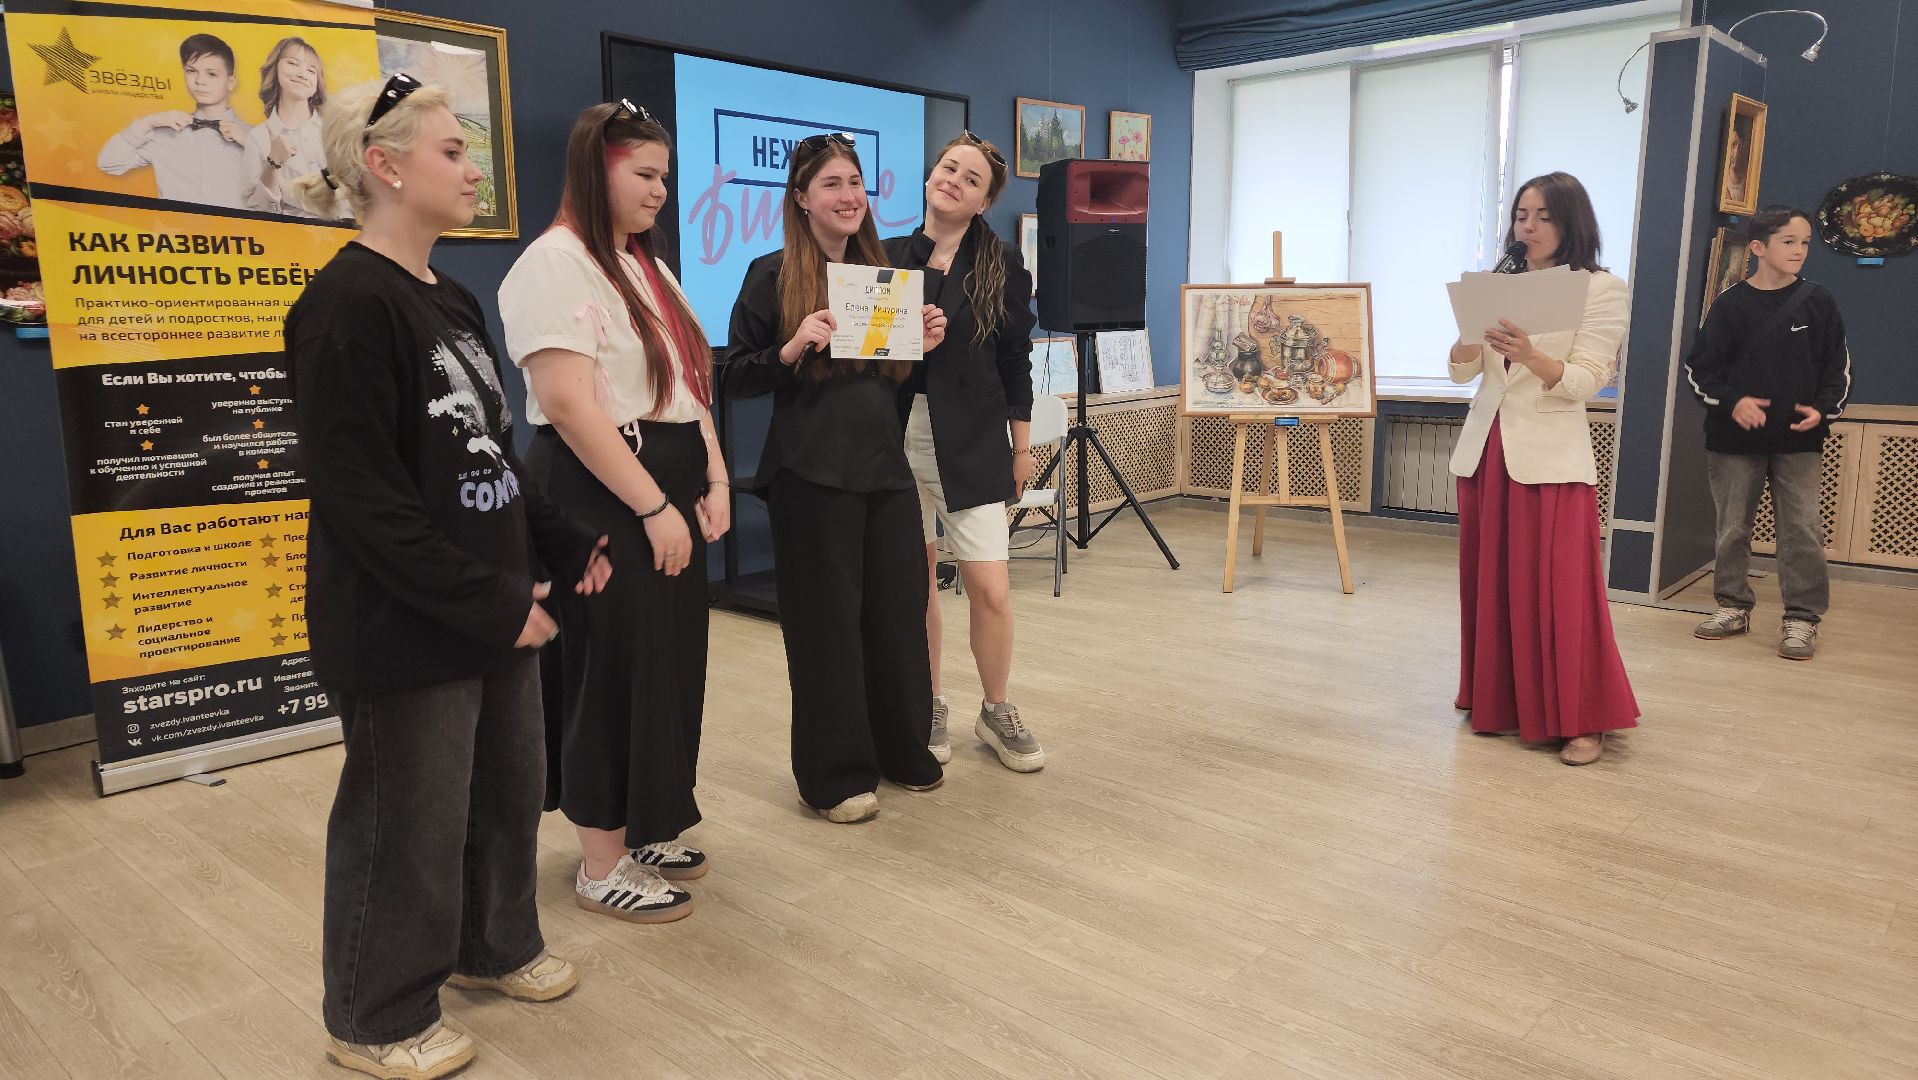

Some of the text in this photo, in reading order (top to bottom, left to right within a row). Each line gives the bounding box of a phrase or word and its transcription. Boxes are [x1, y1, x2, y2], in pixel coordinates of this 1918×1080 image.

[68, 231, 265, 256] КАК РАЗВИТЬ
[72, 265, 232, 286] ЛИЧНОСТЬ
[76, 298, 280, 310] Практико-ориентированная
[78, 316, 104, 326] для
[108, 314, 153, 326] детей
[156, 316, 165, 324] и
[168, 315, 254, 326] подростков,
[79, 333, 97, 341] на
[102, 330, 203, 343] всестороннее
[207, 329, 270, 342] развитие
[102, 368, 287, 386] Если Вы хотите, чтобы
[244, 406, 283, 415] публике
[104, 420, 128, 428] стал
[138, 426, 161, 434] себе
[202, 434, 221, 442] был
[222, 432, 250, 440] более
[222, 440, 264, 450] научился
[96, 452, 199, 466] получил мотивацию
[246, 447, 286, 456] команде
[98, 464, 149, 474] обучению
[159, 458, 207, 470] успешной
[272, 470, 296, 478] опыт
[116, 470, 185, 482] деятельности
[244, 486, 288, 496] проектов
[119, 526, 156, 542] Для
[160, 522, 192, 535] Вас
[196, 513, 280, 534] работают
[127, 539, 252, 562] Подготовка к школе
[130, 560, 248, 581] Развитие личности
[132, 579, 248, 602] Интеллектуальное
[134, 598, 192, 616] развитие
[136, 616, 214, 634] Лидерство и
[138, 628, 211, 647] социальное
[139, 636, 241, 659] проектирование
[122, 674, 206, 694] Заходите на сайт:
[123, 676, 263, 714] starspro.ru
[278, 693, 329, 714] +7 99
[150, 708, 230, 730] zvezdy.ivanteevka
[152, 714, 264, 742] vk.com/zvezdy.ivanteevka
